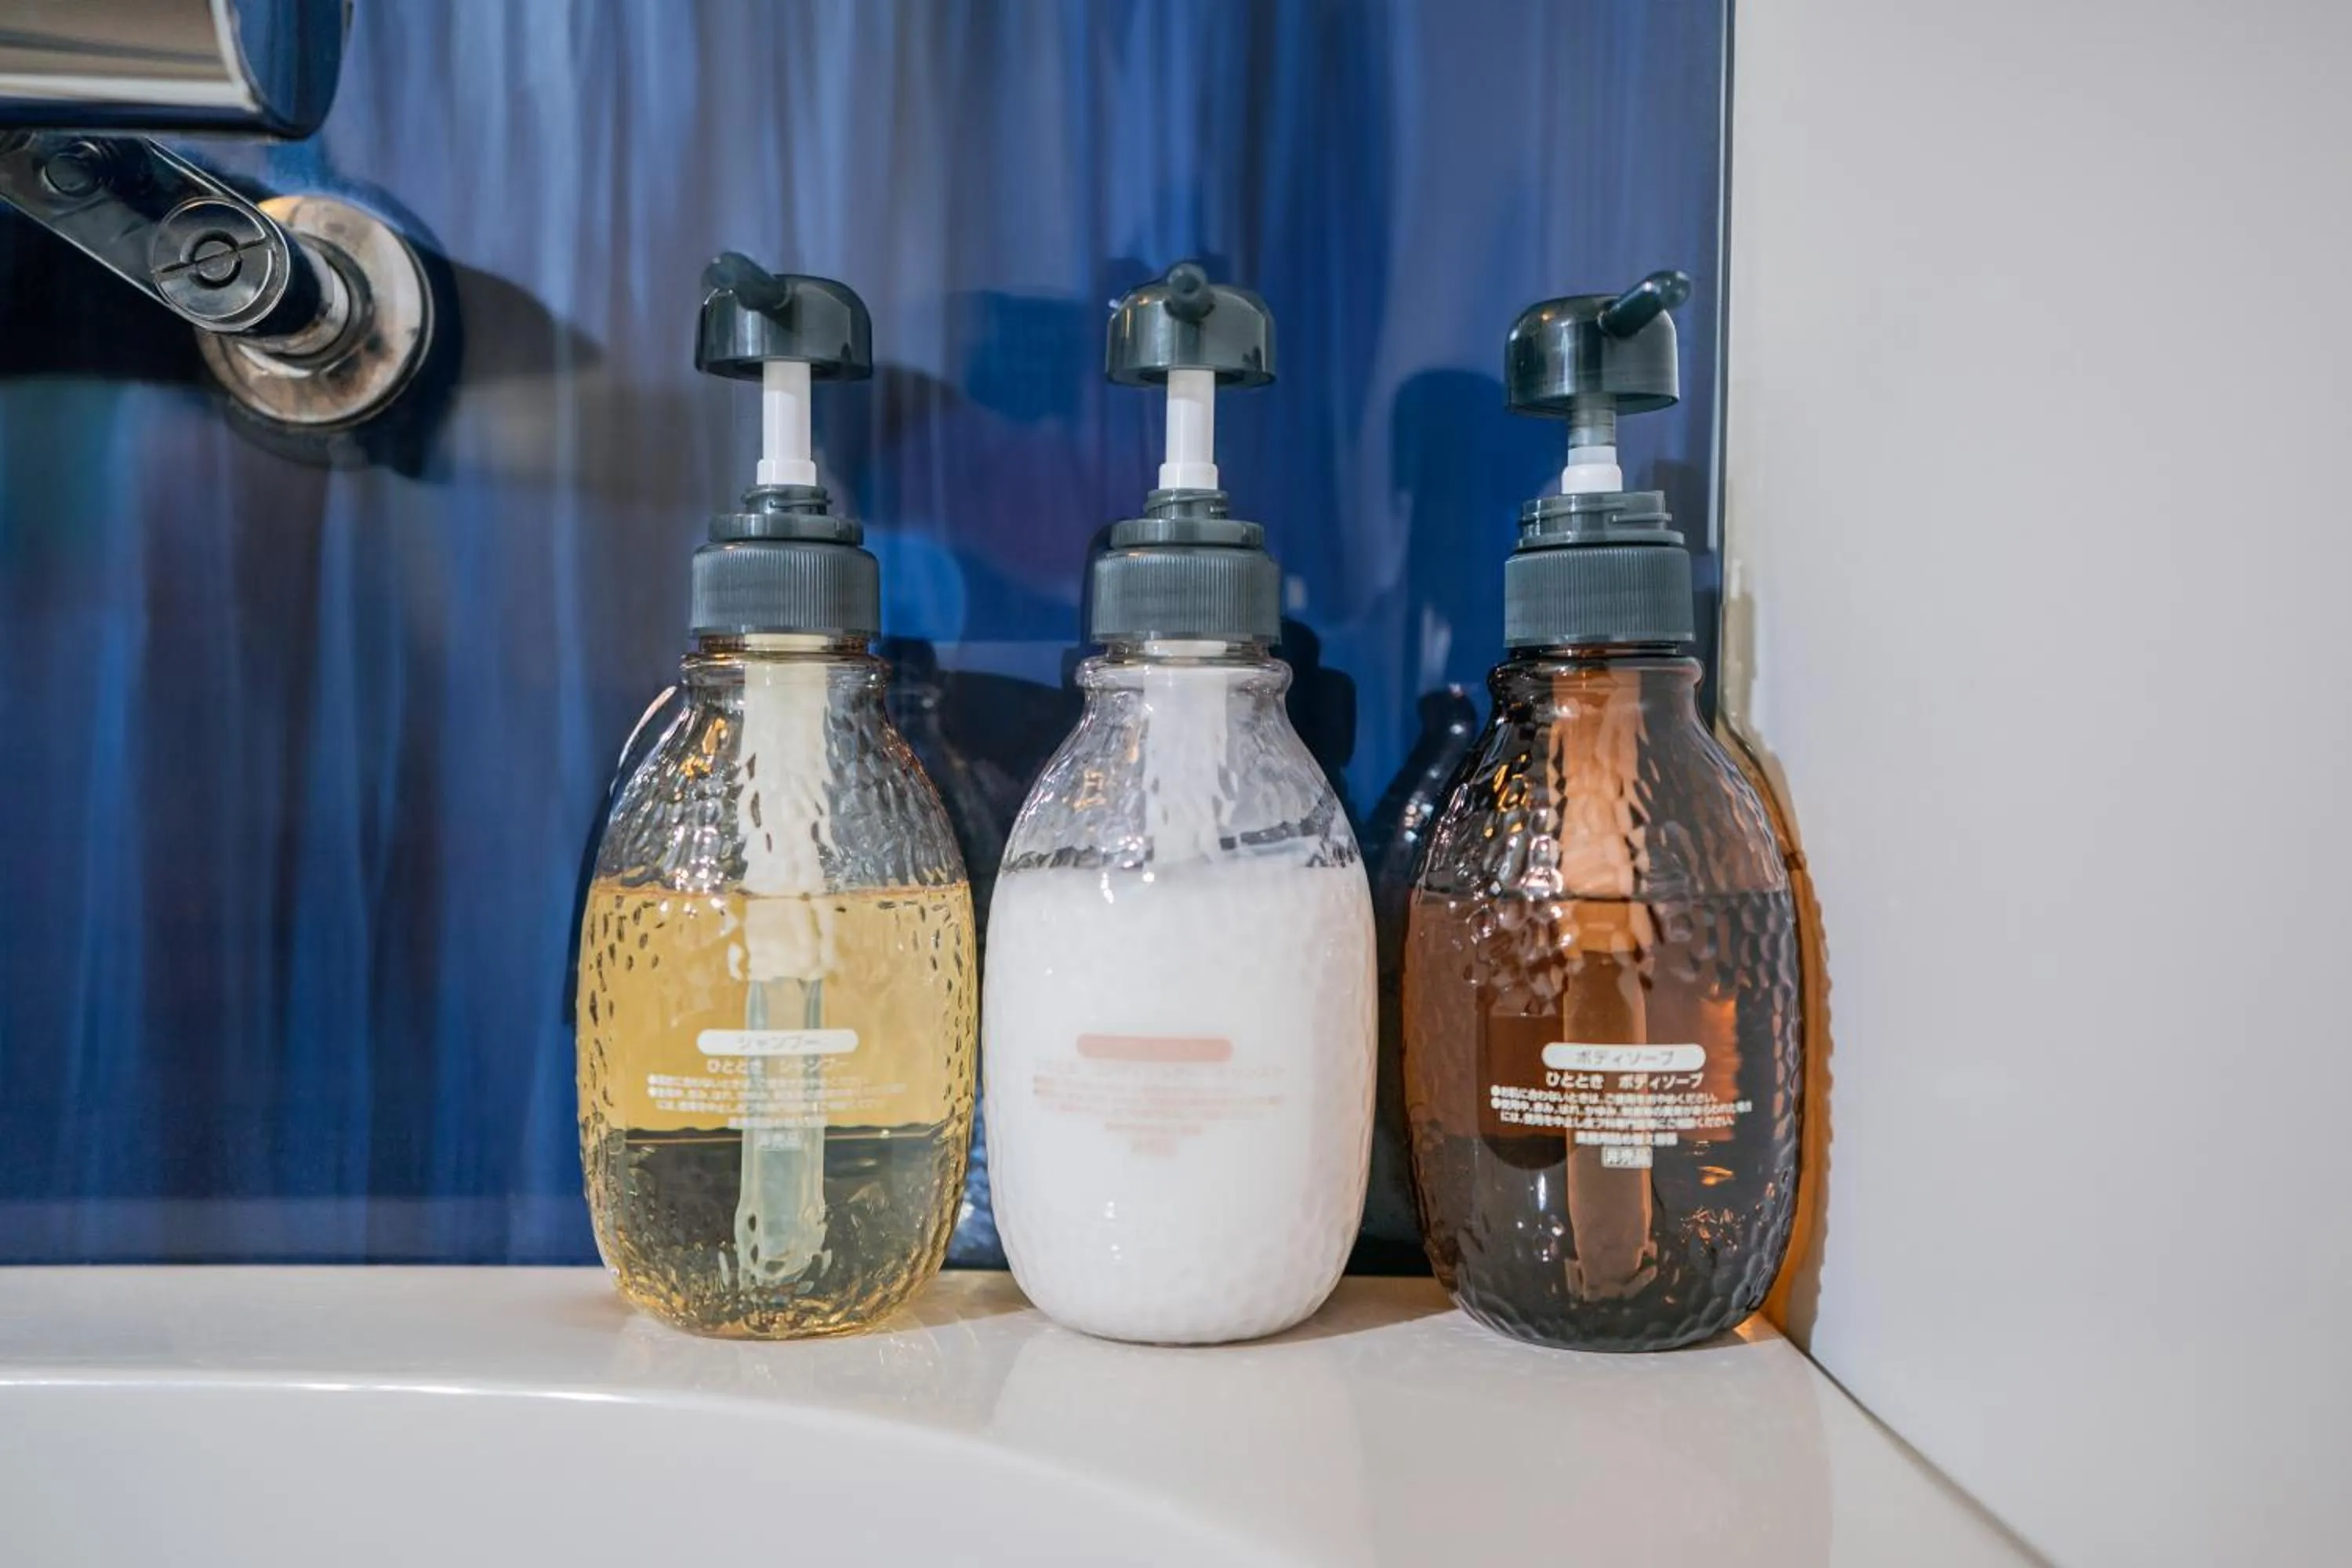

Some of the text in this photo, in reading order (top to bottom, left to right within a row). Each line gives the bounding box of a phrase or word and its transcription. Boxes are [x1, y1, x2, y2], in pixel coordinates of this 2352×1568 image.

[1575, 1048, 1675, 1066] ボディソープ
[1545, 1072, 1704, 1090] ひととき ボディソープ
